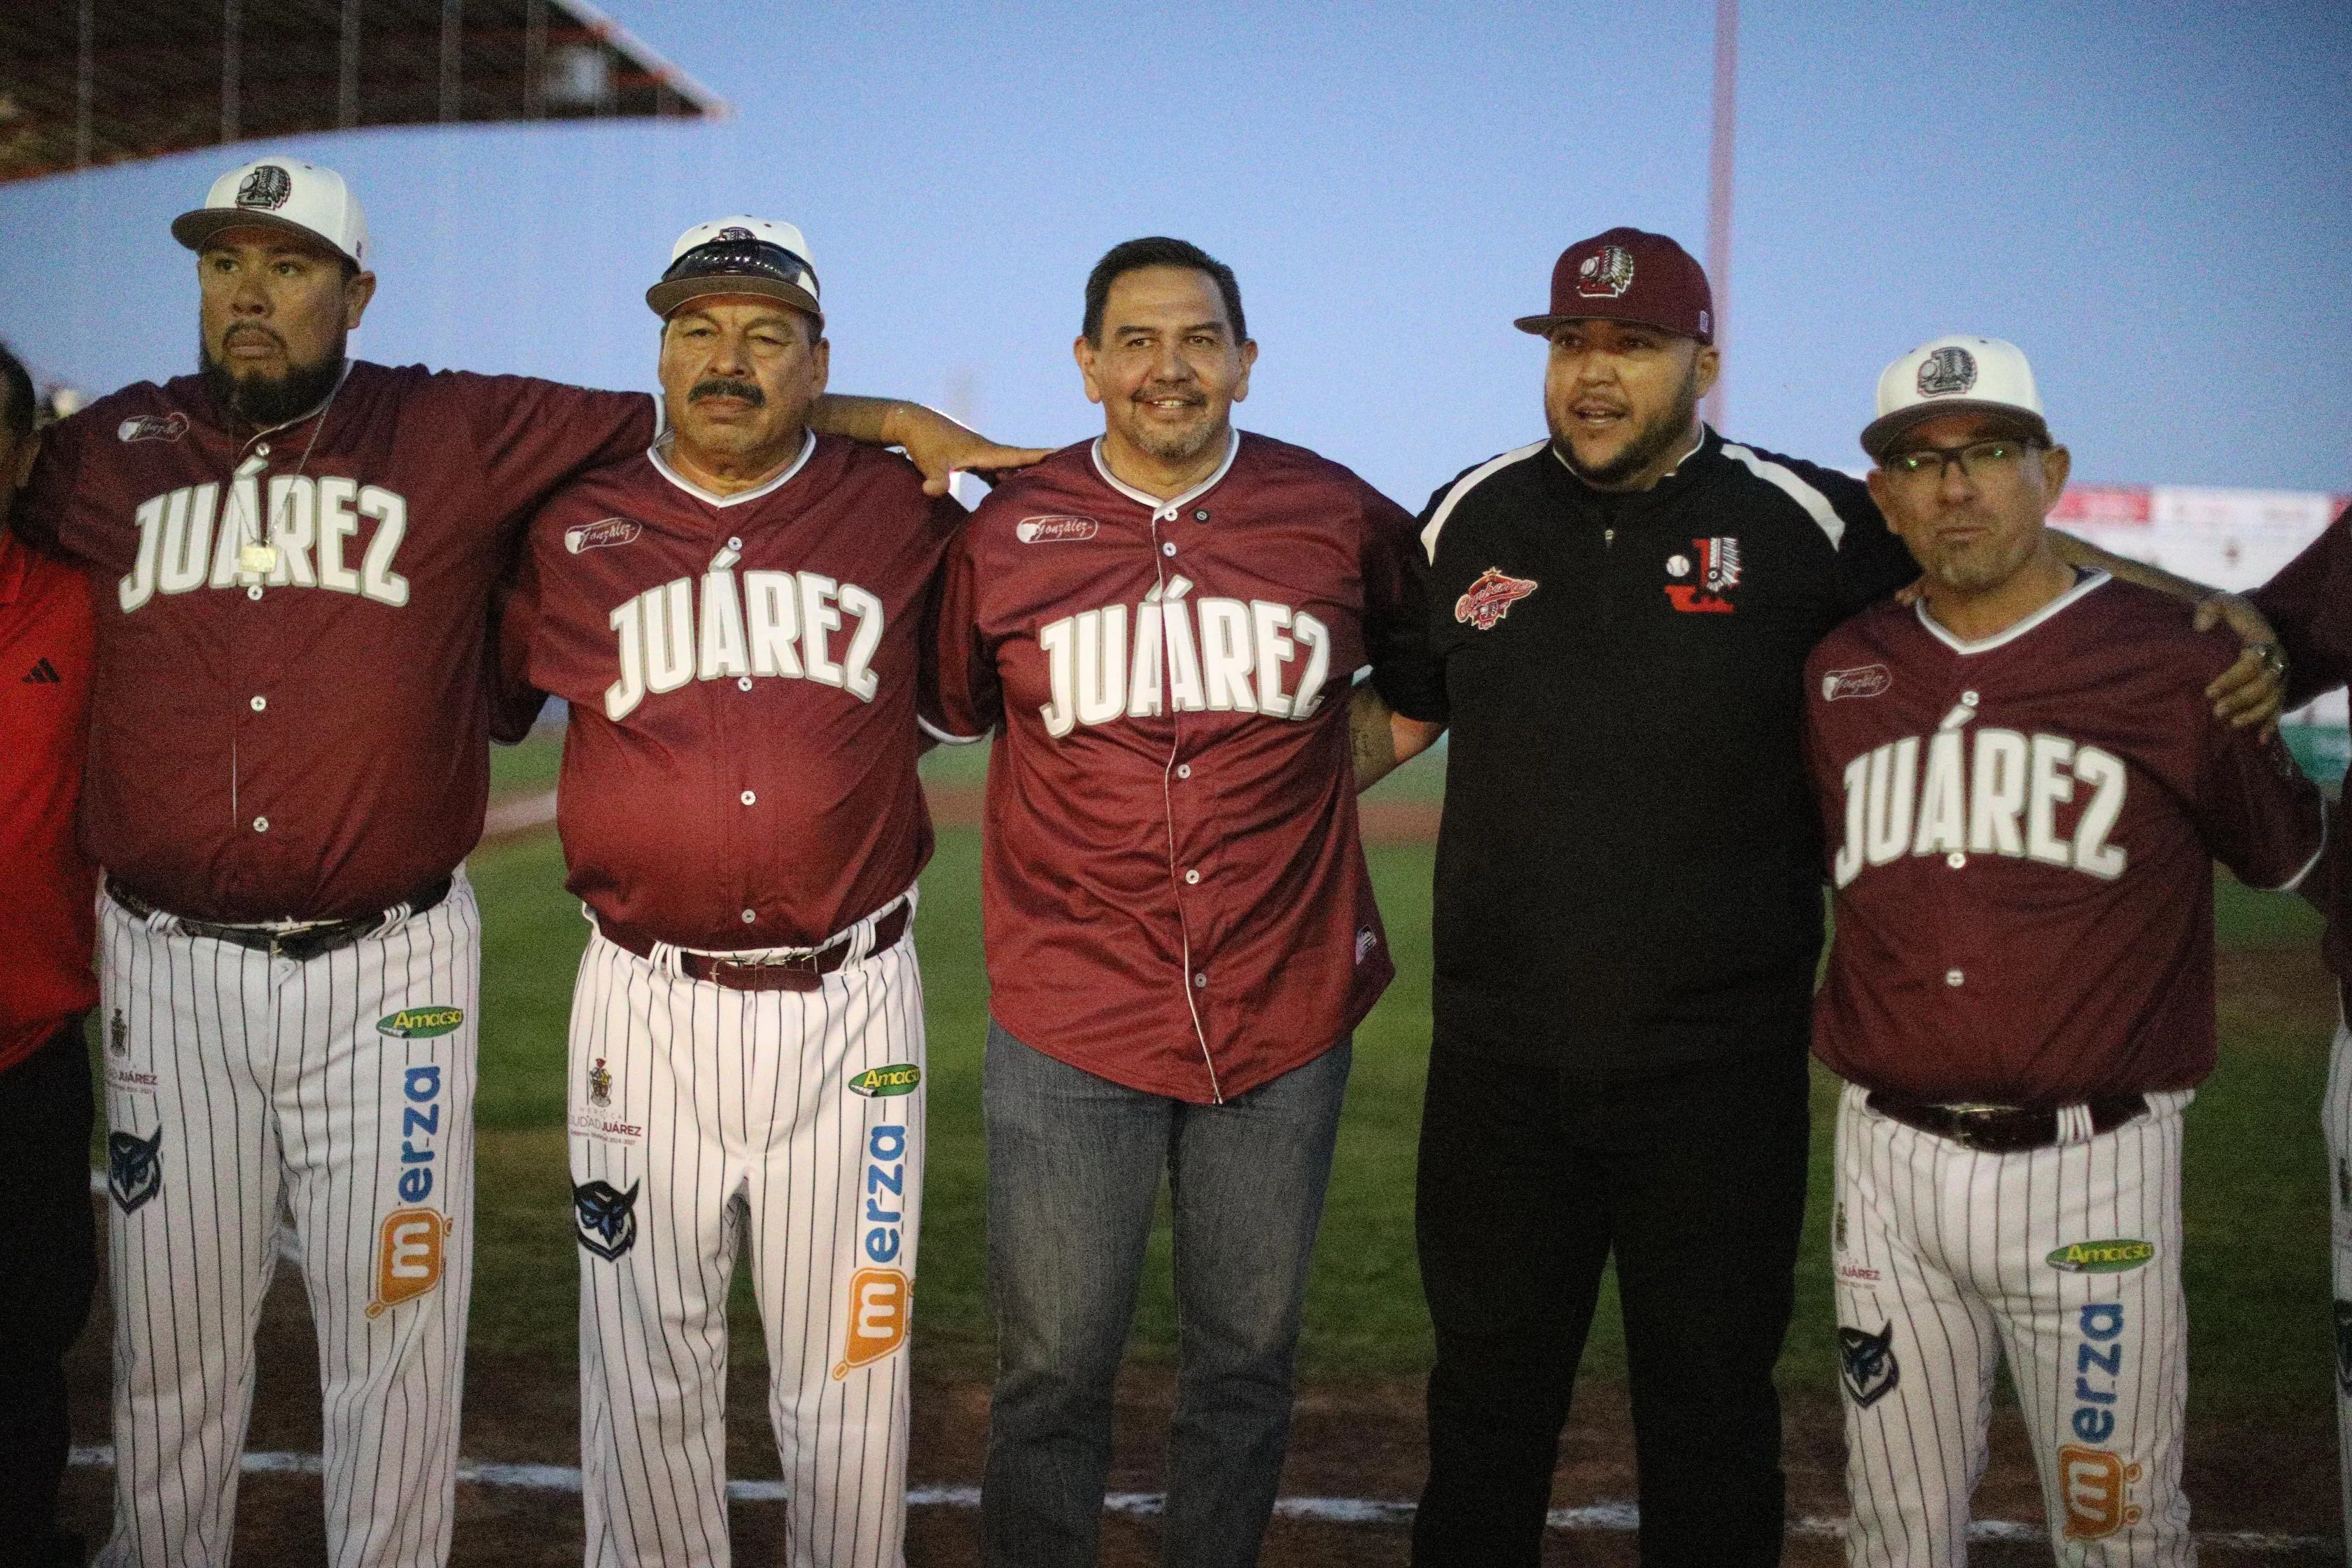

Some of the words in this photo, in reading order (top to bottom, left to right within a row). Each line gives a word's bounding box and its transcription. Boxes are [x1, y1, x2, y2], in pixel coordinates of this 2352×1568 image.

[118, 456, 410, 614] JUÁREZ
[605, 546, 885, 722] JUÁREZ
[1039, 574, 1331, 738] JUÁREZ
[1833, 704, 2128, 890] JUÁREZ
[602, 1120, 642, 1137] JUÁREZ
